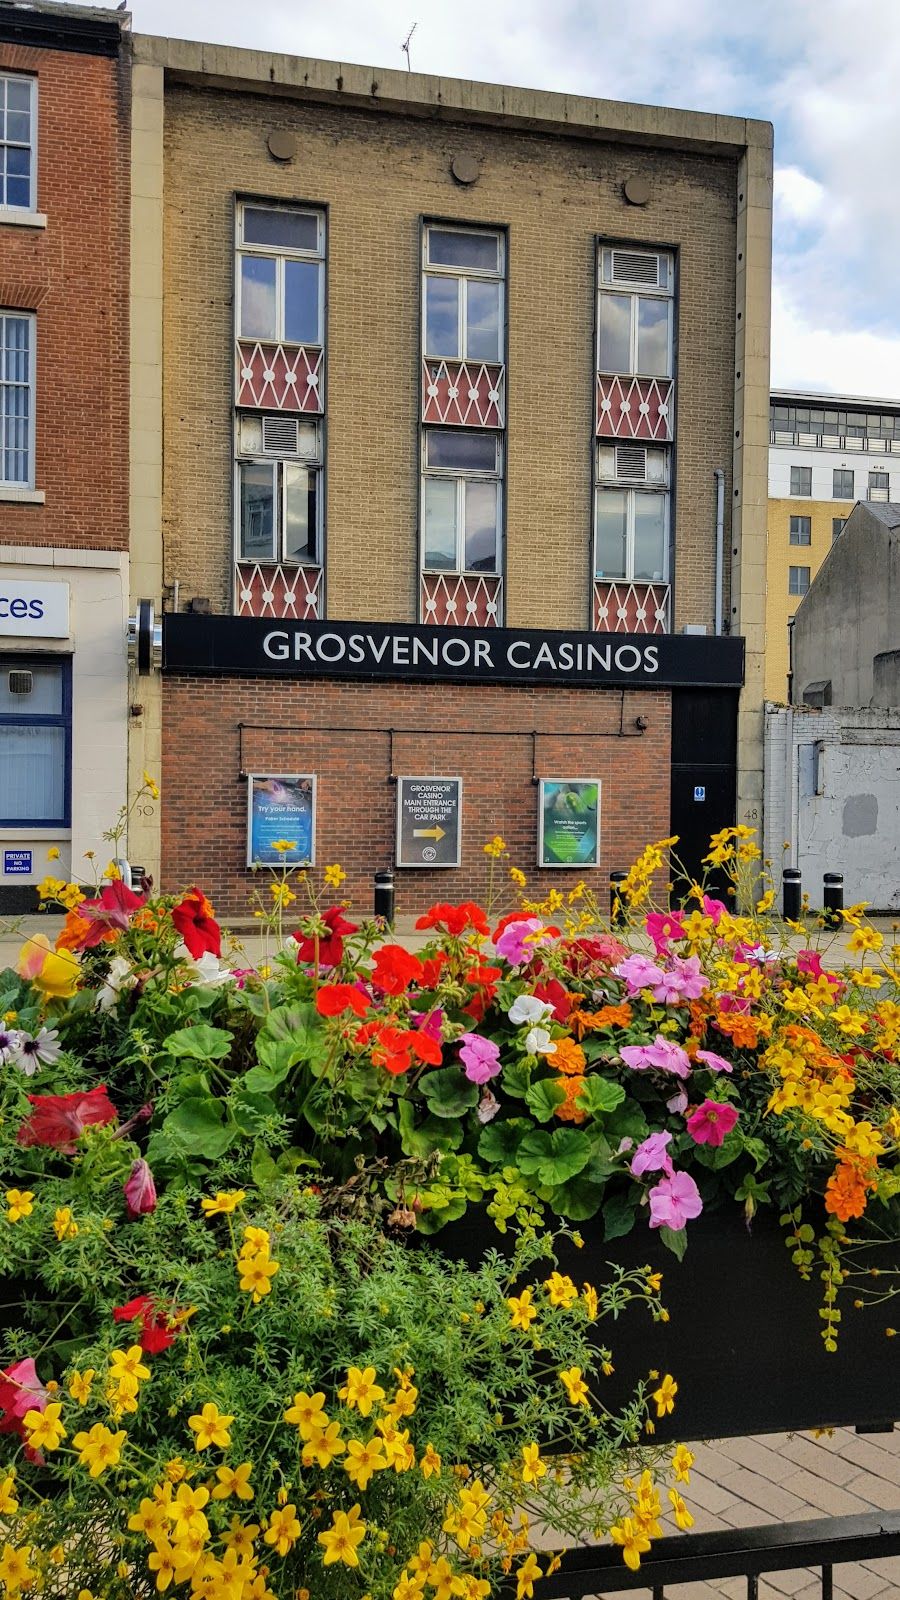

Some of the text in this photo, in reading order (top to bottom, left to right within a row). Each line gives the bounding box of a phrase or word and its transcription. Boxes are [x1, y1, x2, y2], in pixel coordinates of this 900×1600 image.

[263, 631, 659, 673] GROSVENOR CASINOS
[743, 808, 758, 820] 48
